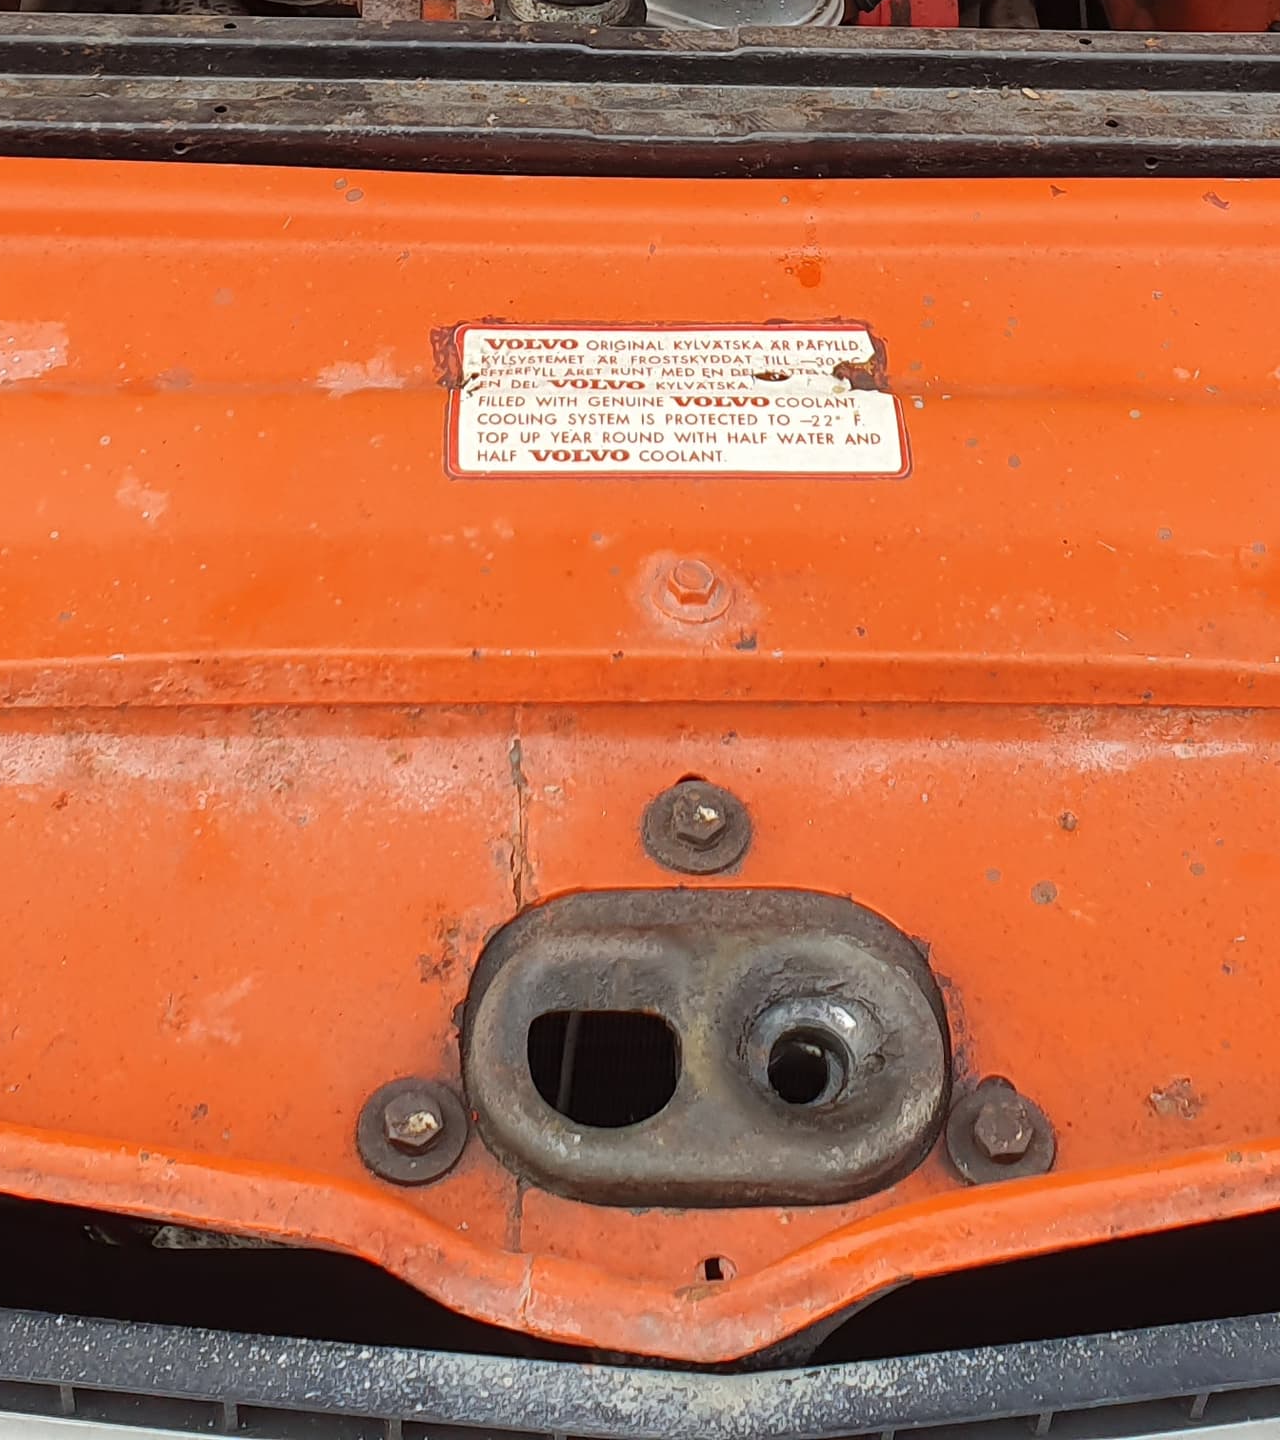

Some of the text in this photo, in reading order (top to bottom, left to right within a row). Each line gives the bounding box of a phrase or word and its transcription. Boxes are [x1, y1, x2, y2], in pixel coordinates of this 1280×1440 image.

[484, 338, 579, 350] VOLVO
[586, 340, 665, 351] ORIGINAL
[673, 339, 764, 351] KYLVÄTSKA
[770, 339, 790, 351] ÄR
[480, 354, 585, 365] KYLSYSTEMET
[631, 355, 752, 365] FROSTSKYDDAT
[764, 355, 791, 366] TILL
[611, 367, 653, 377] RUNT
[662, 368, 695, 377] MED
[702, 368, 723, 377] EN
[480, 380, 501, 389] EN
[511, 380, 538, 389] DEL
[547, 378, 646, 390] VOLVO
[478, 396, 525, 407] FILLED
[536, 396, 578, 407] WITH
[588, 396, 664, 407] GENUINE
[670, 396, 770, 407] VOLVO
[477, 413, 557, 425] COOLING
[568, 413, 630, 425] SYSTEM
[641, 413, 655, 425] IS
[666, 413, 758, 426] PROTECTED
[768, 414, 791, 426] TO
[477, 431, 881, 445] TOP UP YEAR ROUND WITH HALF WATER AND
[477, 450, 517, 462] HALF
[528, 449, 630, 462] VOLVO
